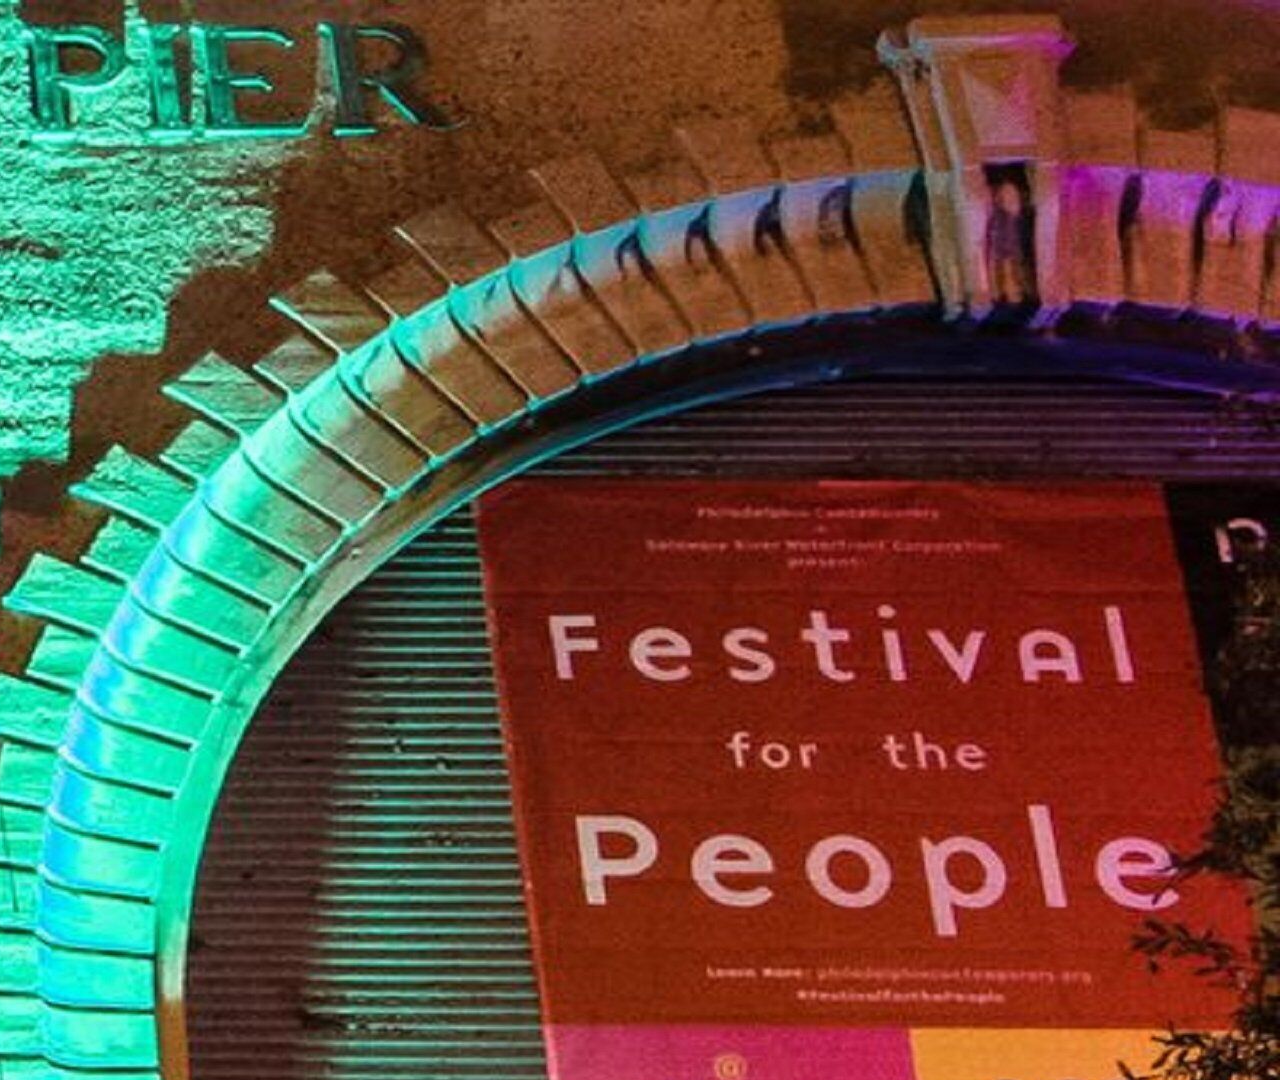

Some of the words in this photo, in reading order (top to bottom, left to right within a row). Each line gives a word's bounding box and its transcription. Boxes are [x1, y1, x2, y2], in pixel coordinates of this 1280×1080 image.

[25, 20, 470, 143] PIER
[726, 731, 818, 770] for
[883, 731, 988, 770] the
[574, 804, 1179, 937] People
